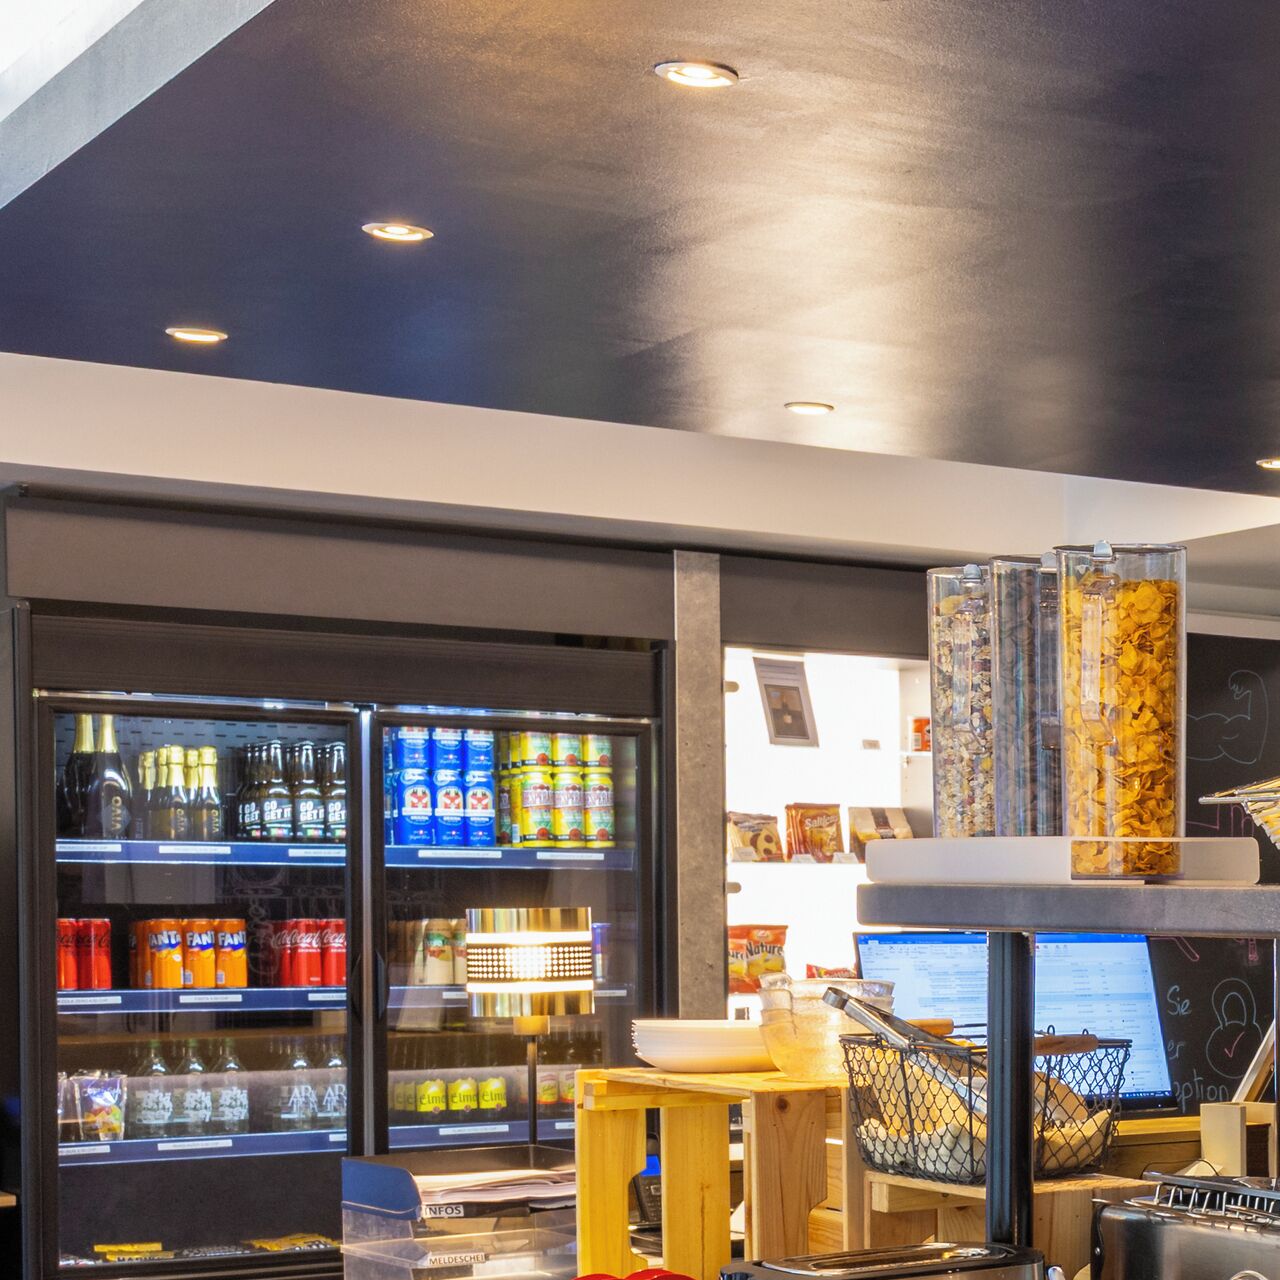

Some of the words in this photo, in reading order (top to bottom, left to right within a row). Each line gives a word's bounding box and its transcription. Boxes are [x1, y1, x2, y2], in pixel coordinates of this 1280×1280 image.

[244, 802, 256, 813] GO
[263, 800, 278, 811] GO
[300, 801, 314, 811] GO
[328, 801, 342, 812] GO
[746, 941, 784, 958] Nature
[1167, 985, 1192, 1016] Sie
[425, 1206, 462, 1216] INFOS
